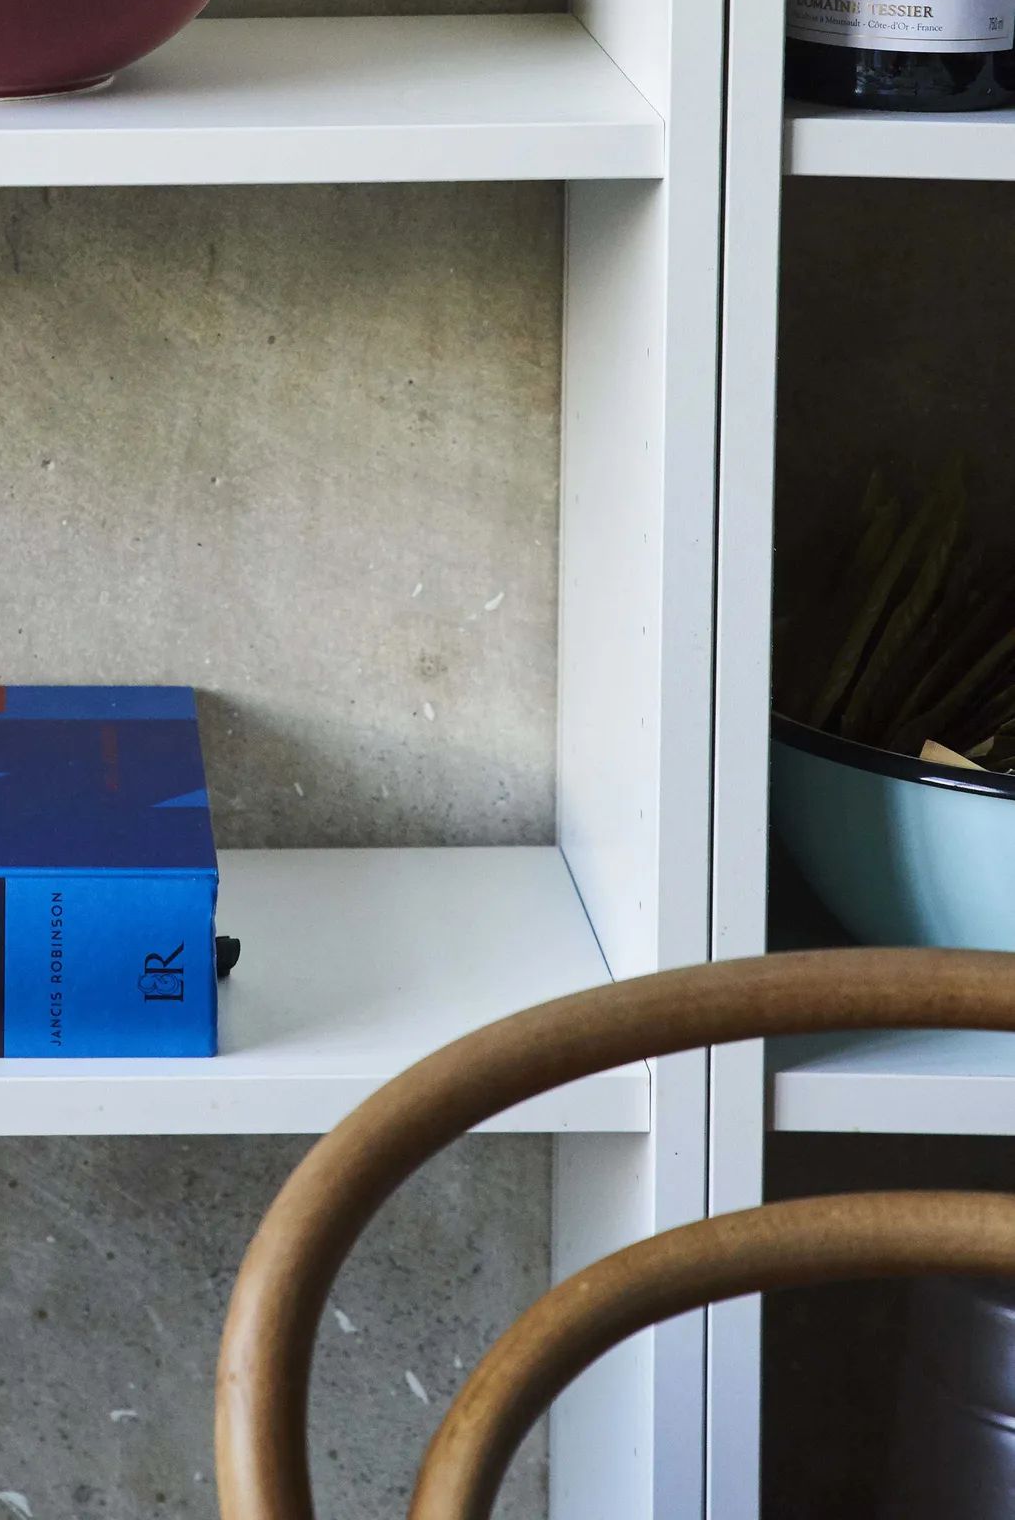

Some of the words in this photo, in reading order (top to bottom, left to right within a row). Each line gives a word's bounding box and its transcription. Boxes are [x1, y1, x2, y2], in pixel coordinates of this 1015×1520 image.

[867, 2, 934, 18] TESSIER
[916, 22, 944, 32] France
[50, 891, 63, 984] ROBINSON
[50, 991, 62, 1047] JANCIS
